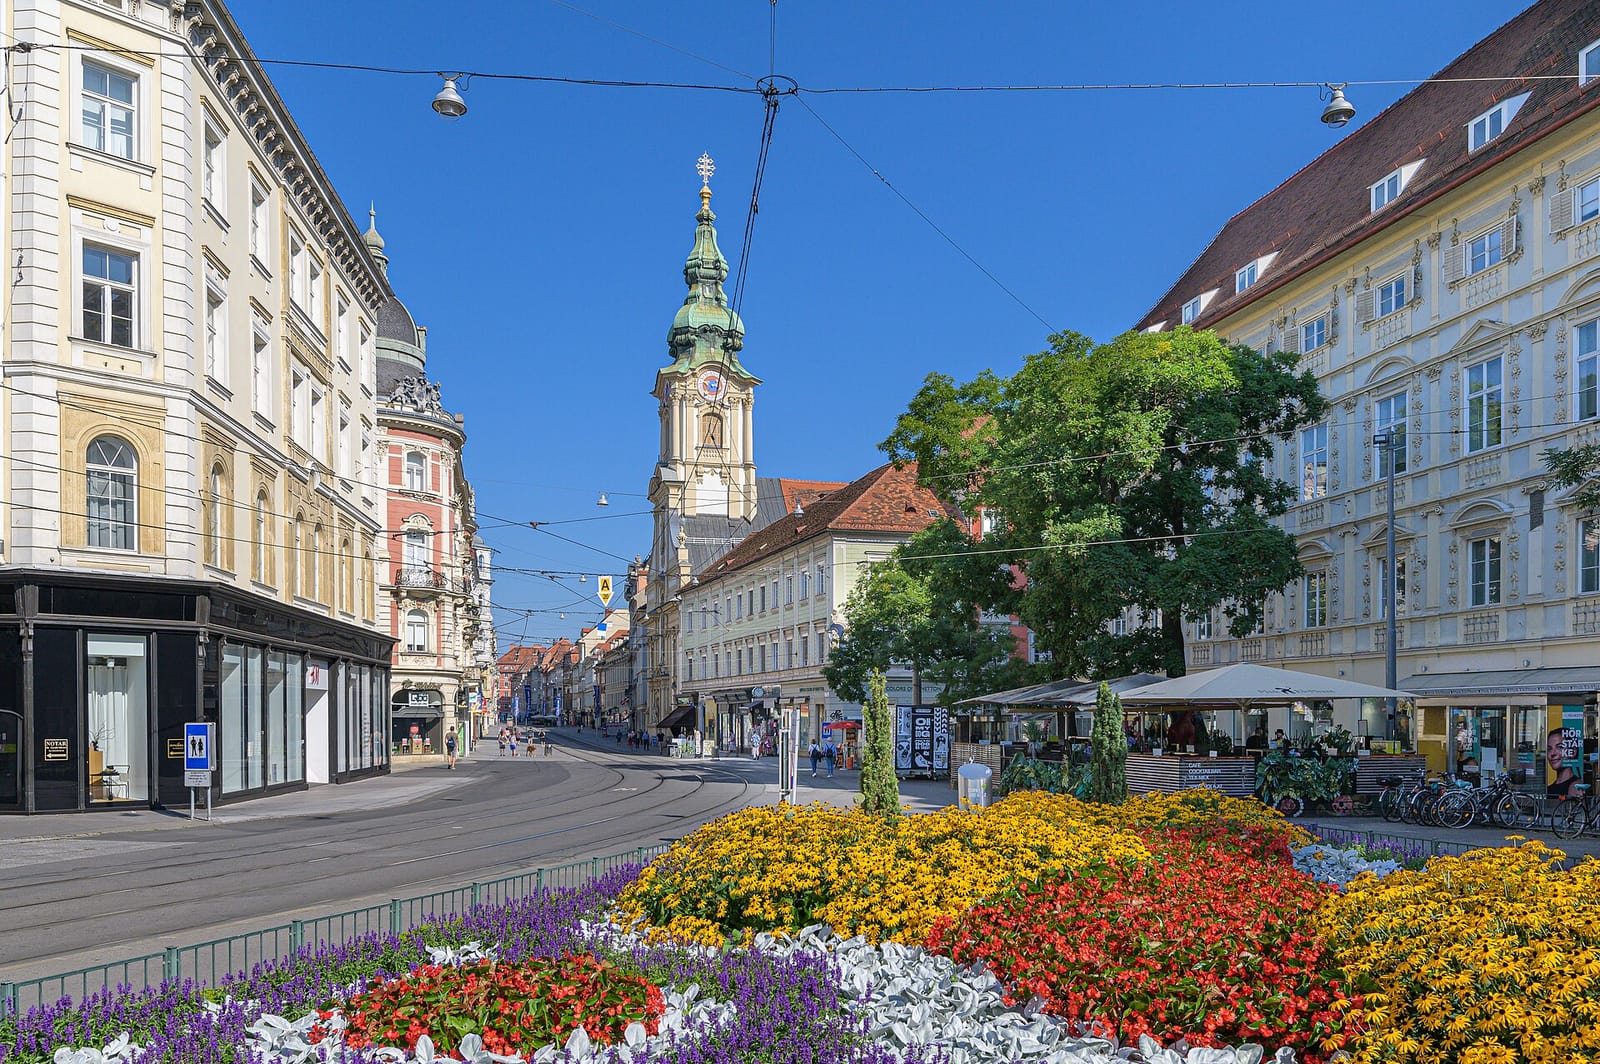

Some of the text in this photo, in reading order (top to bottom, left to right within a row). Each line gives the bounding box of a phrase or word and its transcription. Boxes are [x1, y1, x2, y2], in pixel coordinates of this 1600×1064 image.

[601, 579, 610, 591] A
[1562, 727, 1582, 738] HÖR
[1562, 738, 1584, 748] STÄR
[1562, 749, 1575, 757] KE
